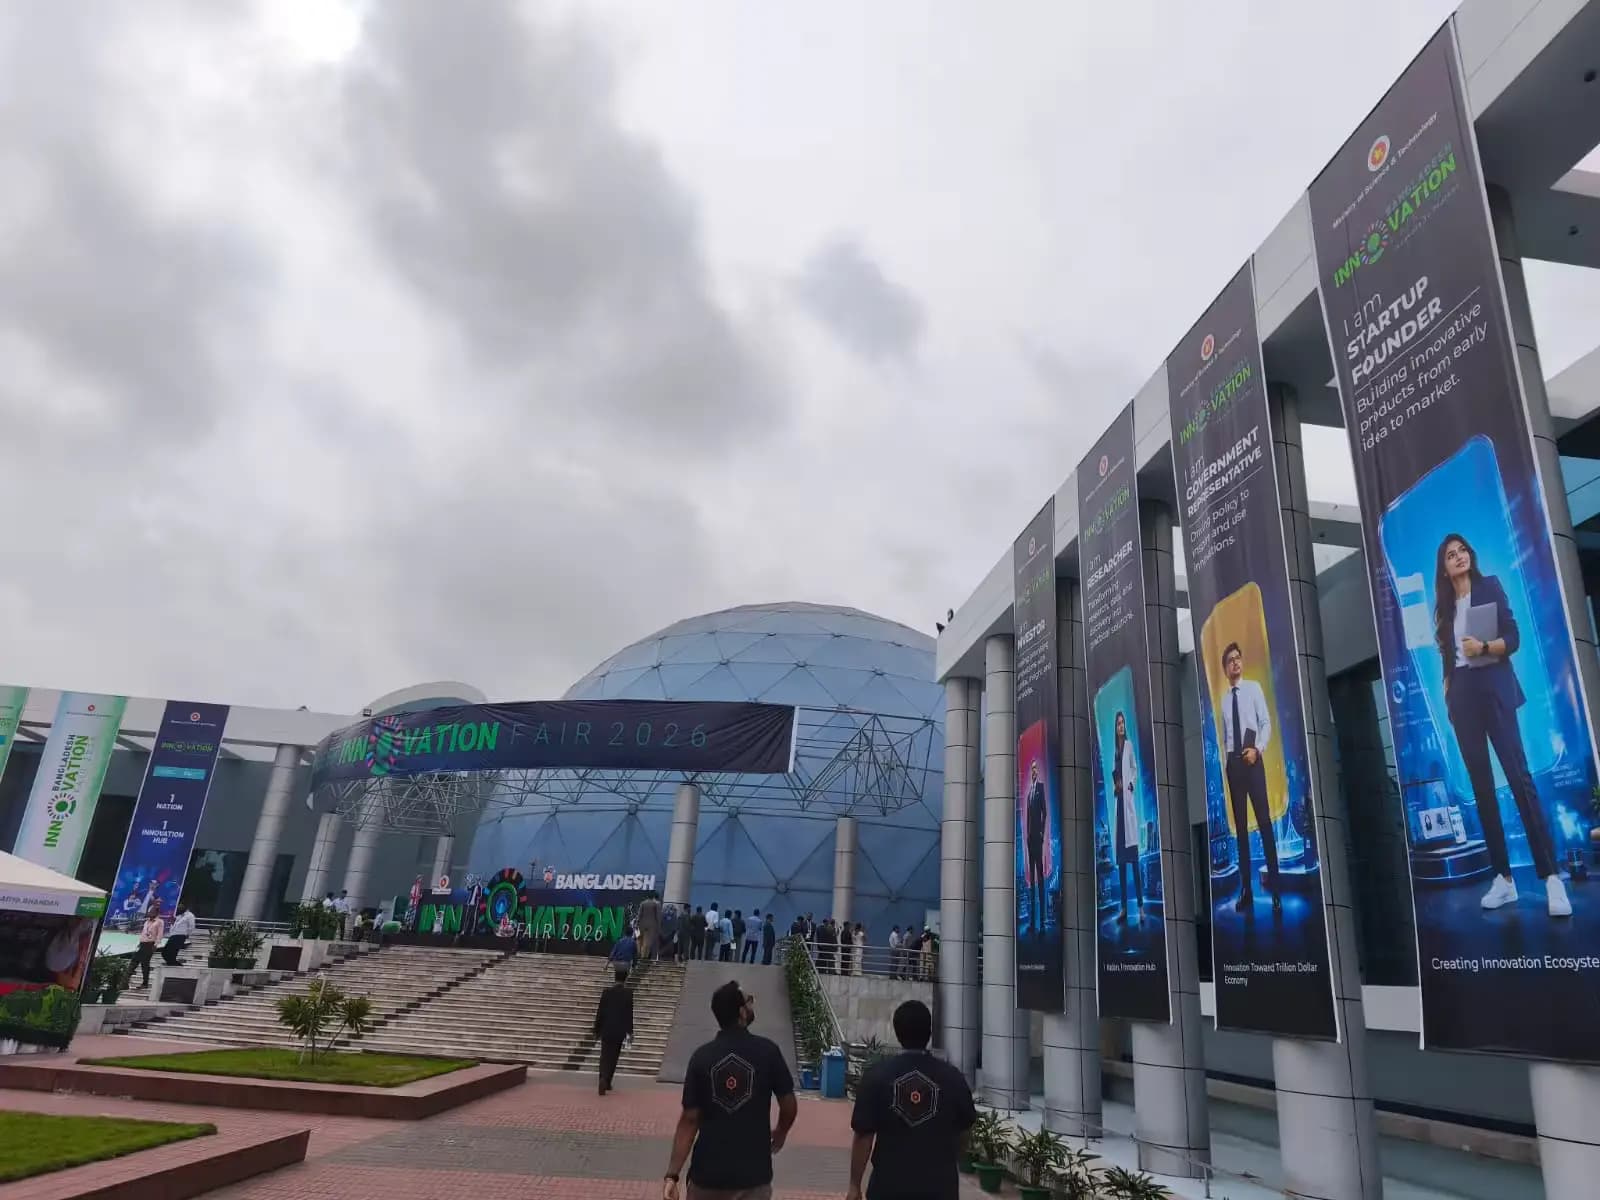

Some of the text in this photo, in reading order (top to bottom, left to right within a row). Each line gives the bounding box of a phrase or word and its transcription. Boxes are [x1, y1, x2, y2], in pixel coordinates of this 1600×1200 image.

[1343, 293, 1382, 337] I am
[1347, 276, 1429, 360] STARTUP
[1351, 296, 1442, 385] FOUNDER
[1357, 303, 1481, 414] Building innovative
[1360, 319, 1488, 435] products from early
[1362, 373, 1460, 452] idea to market.
[1186, 425, 1259, 501] GOVERNMENT
[1188, 445, 1263, 518] REPRESENTATIVE
[1211, 518, 1230, 538] and
[1231, 508, 1247, 526] use
[1212, 496, 1239, 524] policy
[1240, 489, 1250, 501] to
[1087, 540, 1133, 591] RESEARCHER
[509, 722, 592, 745] FAIR
[607, 722, 708, 748] 2026
[52, 734, 76, 793] BANGLADESH
[156, 801, 183, 811] NATION
[141, 828, 185, 840] INNOVATION
[153, 836, 169, 845] HUB
[554, 873, 656, 891] BANGLADESH
[515, 922, 604, 942] FAIR 2026
[1224, 975, 1248, 987] Economy
[1251, 962, 1275, 973] Toward
[1276, 962, 1297, 973] Trillion
[1297, 962, 1318, 973] Dollar
[1431, 957, 1480, 972] Creating
[1481, 956, 1542, 970] Innovation
